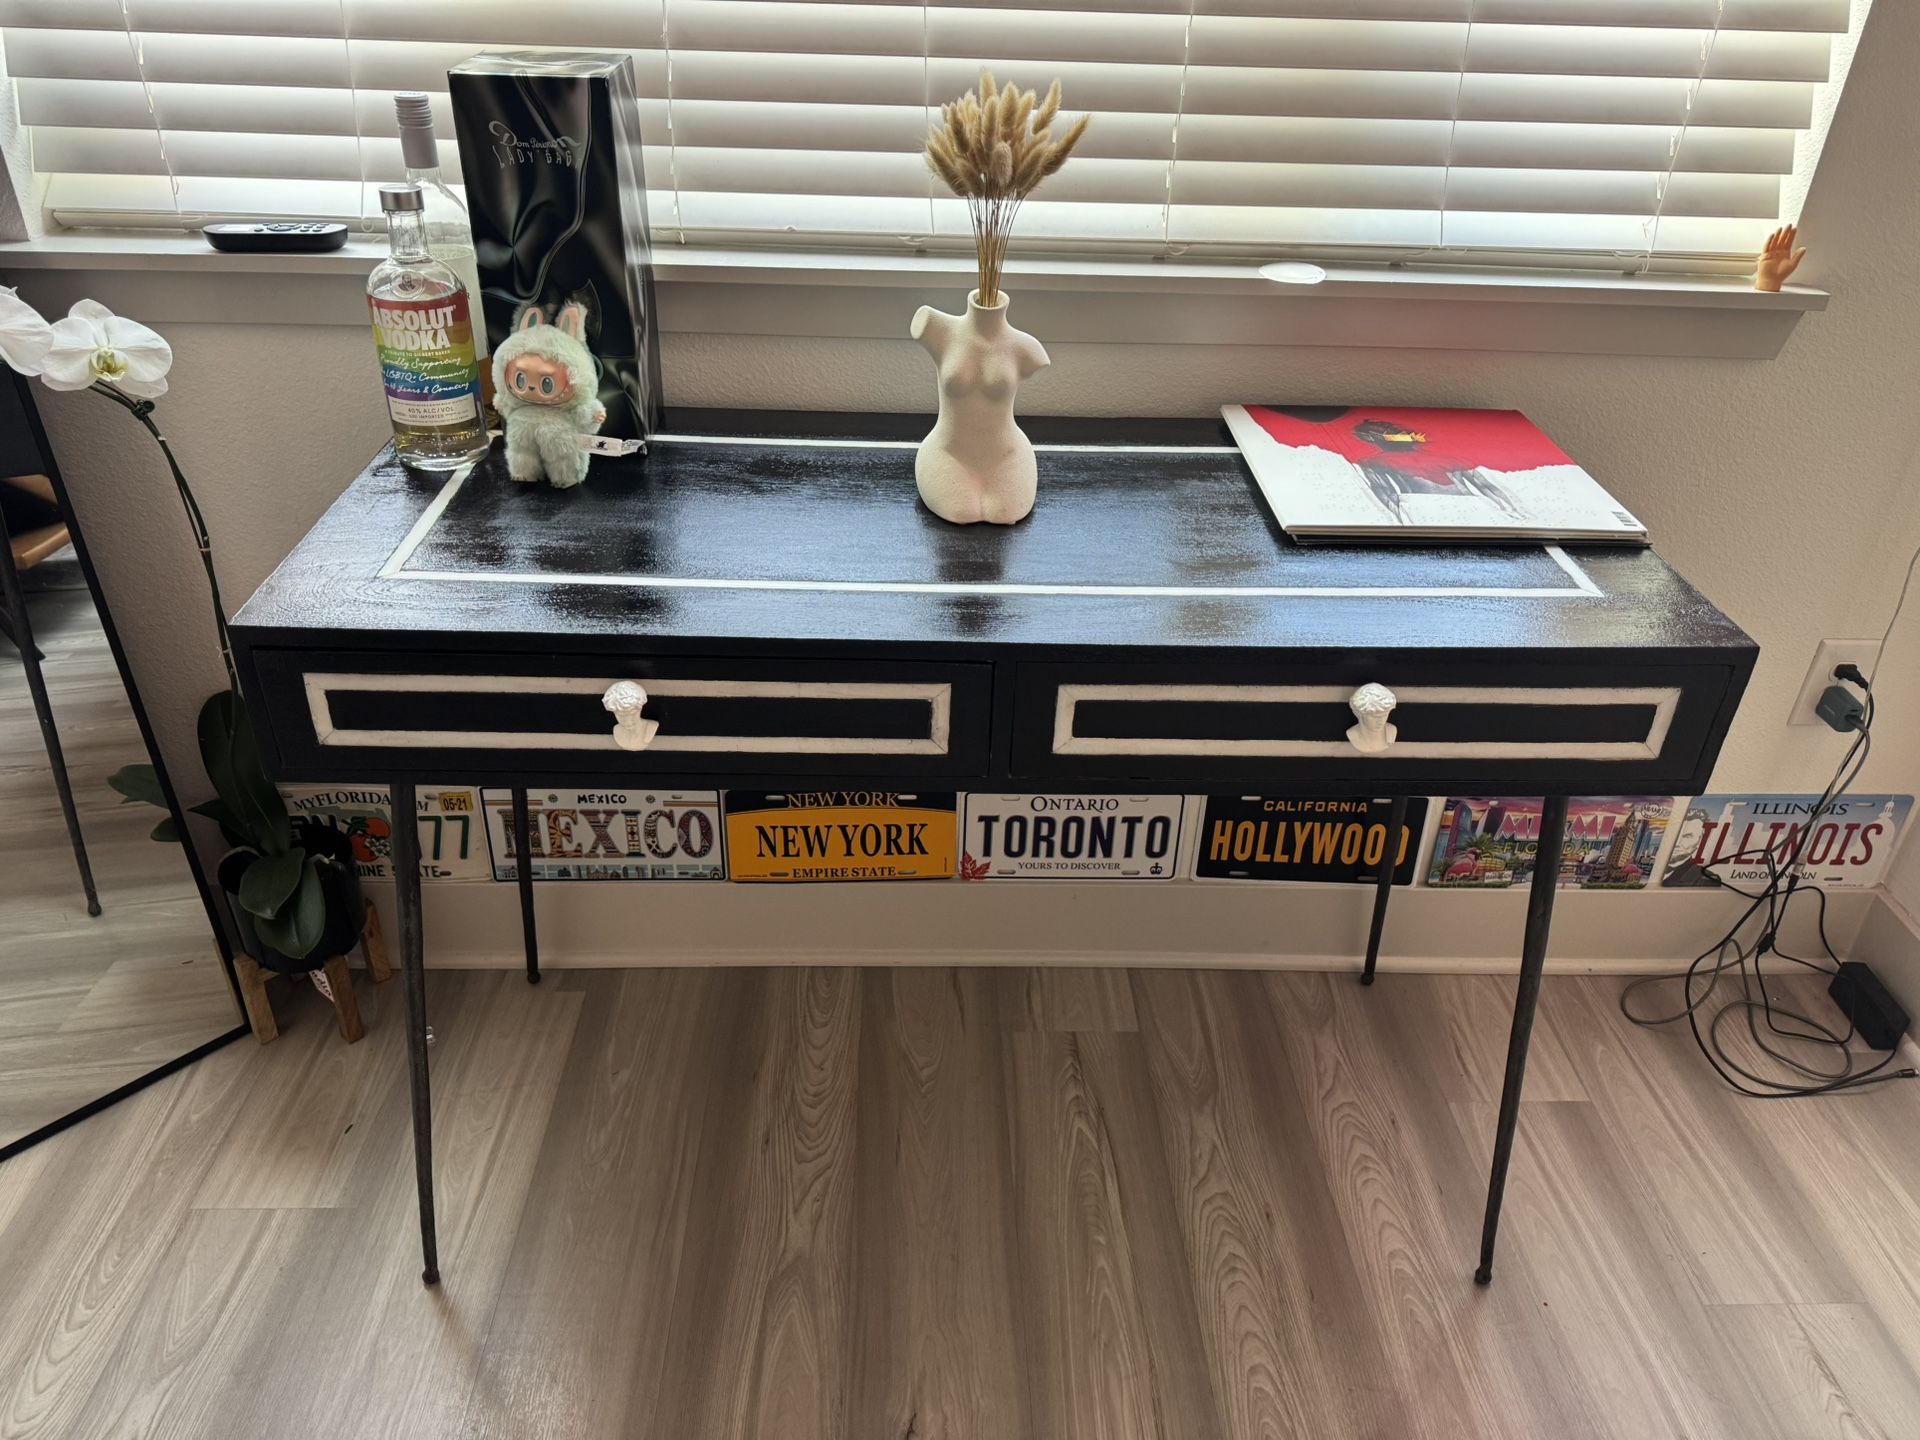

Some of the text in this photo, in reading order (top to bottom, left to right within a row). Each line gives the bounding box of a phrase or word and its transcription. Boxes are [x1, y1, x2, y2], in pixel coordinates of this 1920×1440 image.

[492, 145, 534, 169] LADY
[372, 305, 455, 331] ABSOLUT
[382, 328, 451, 351] VODKA
[419, 368, 469, 382] Community
[431, 382, 469, 394] Counting
[443, 797, 468, 811] 05-21
[577, 794, 627, 804] MEXICO
[786, 791, 900, 807] NEW YORK
[1030, 796, 1119, 812] ONTARIO
[1263, 800, 1368, 813] CALIFORNIA
[1752, 803, 1849, 815] ILLINOIS
[497, 809, 714, 859] MEXICO
[1493, 813, 1617, 841] MIMI
[755, 823, 929, 857] NEW YORK
[977, 815, 1171, 858] TORONTO
[1691, 822, 1884, 866] ILLINOIS
[1503, 841, 1591, 855] FLODA
[793, 866, 896, 878] EMPIRE STATE
[1018, 861, 1121, 870] YOURS TO DISCOVER
[1730, 869, 1757, 880] LAND
